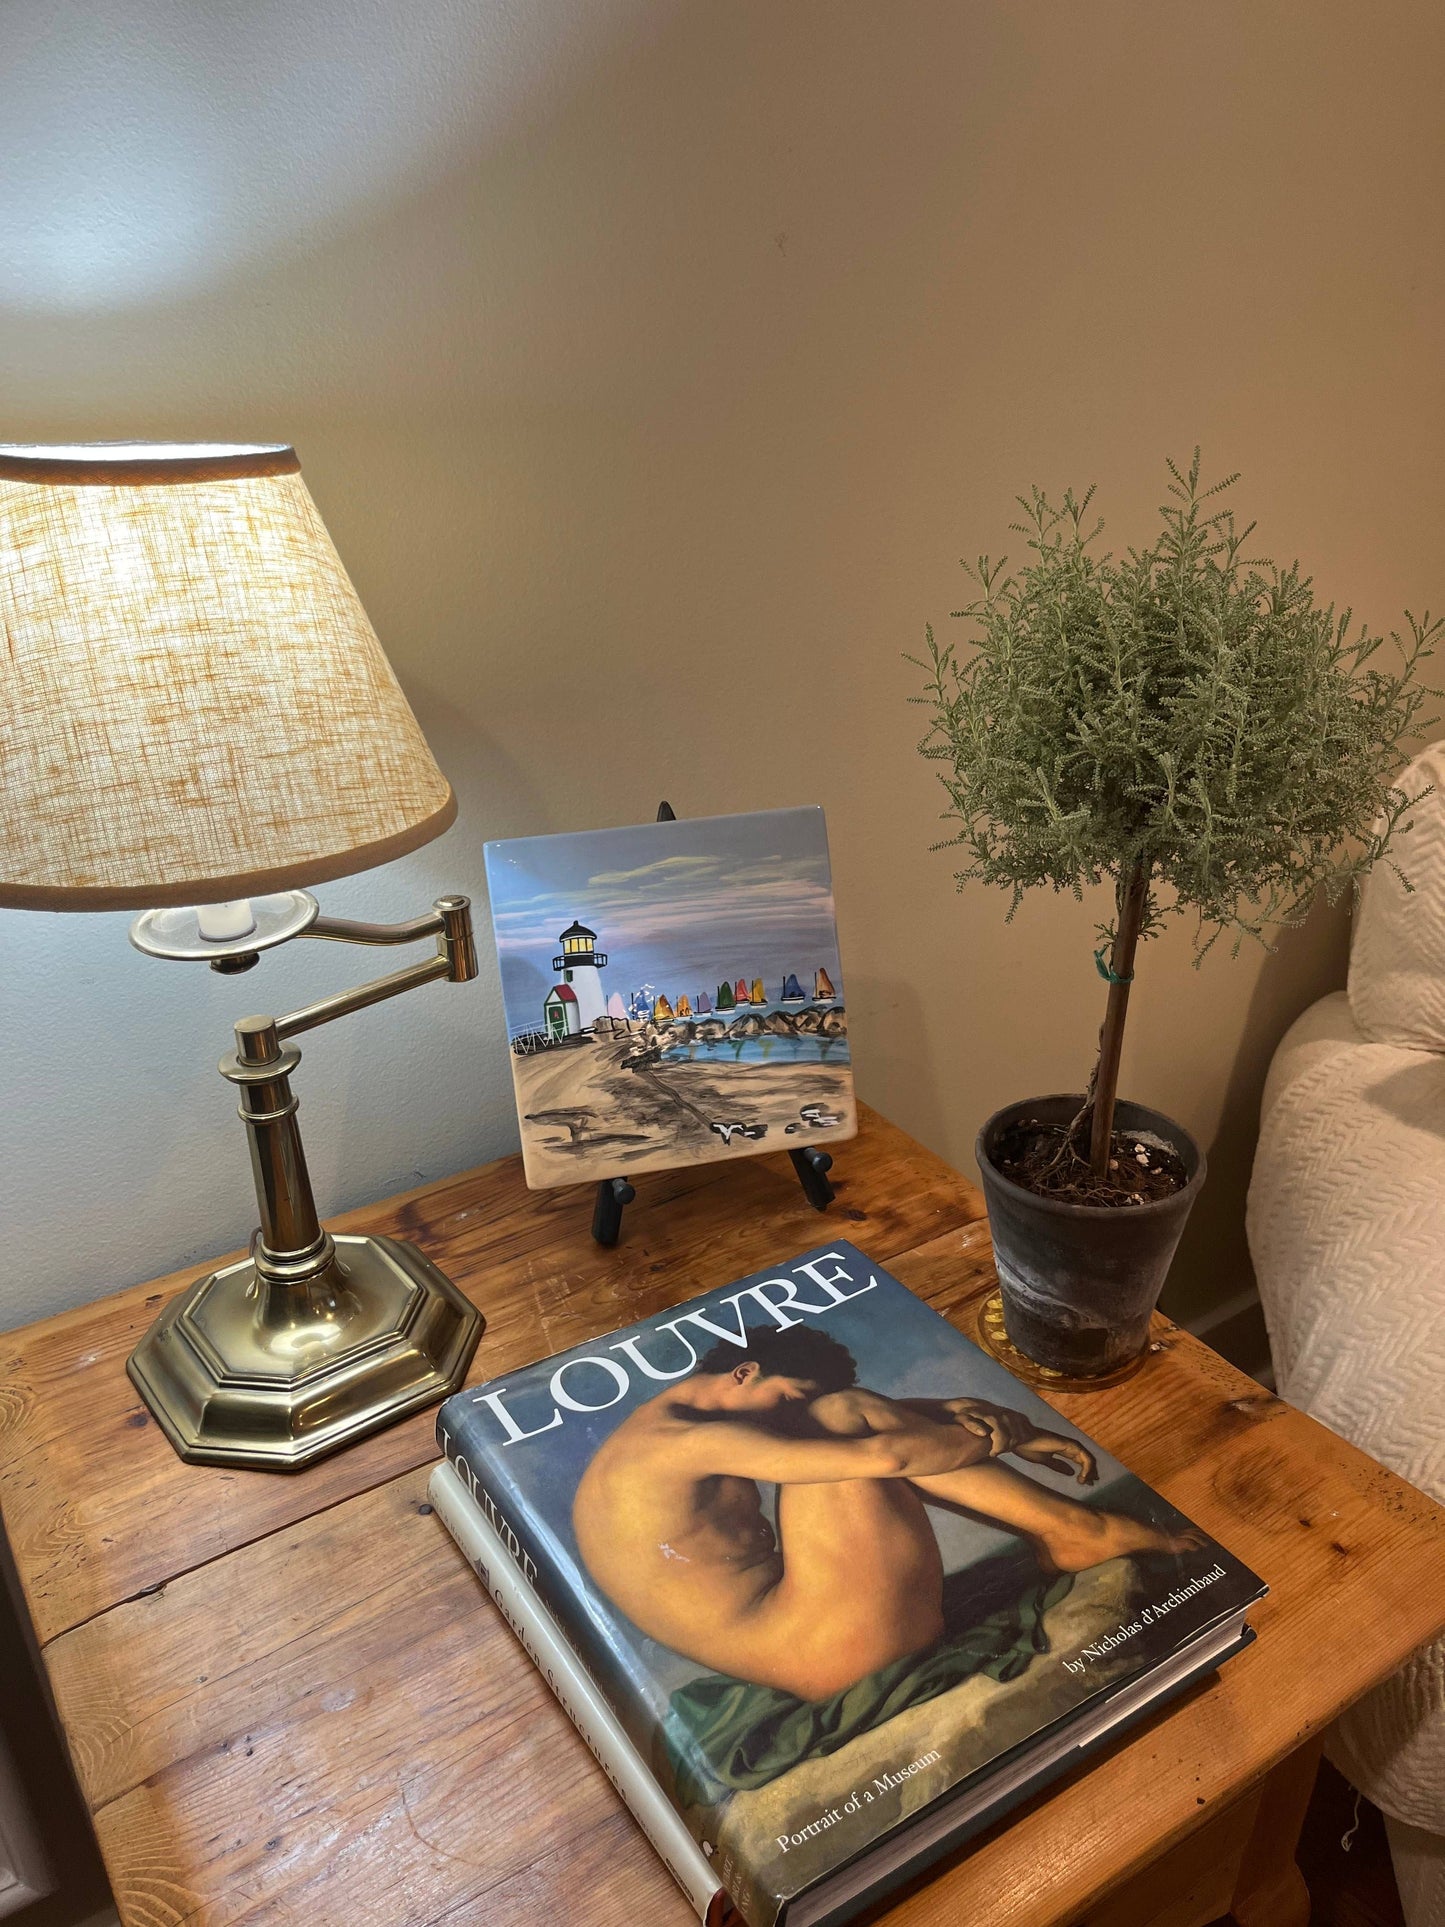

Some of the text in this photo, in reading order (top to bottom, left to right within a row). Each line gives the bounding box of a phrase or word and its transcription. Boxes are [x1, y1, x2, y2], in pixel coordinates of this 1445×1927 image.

[472, 1252, 878, 1446] LOUVRE
[494, 1589, 540, 1667] Garden
[547, 1668, 626, 1800] Structures
[1062, 1563, 1227, 1674] by Nicholas d'Archimbaud
[775, 1750, 942, 1854] Portrait of a Museum
